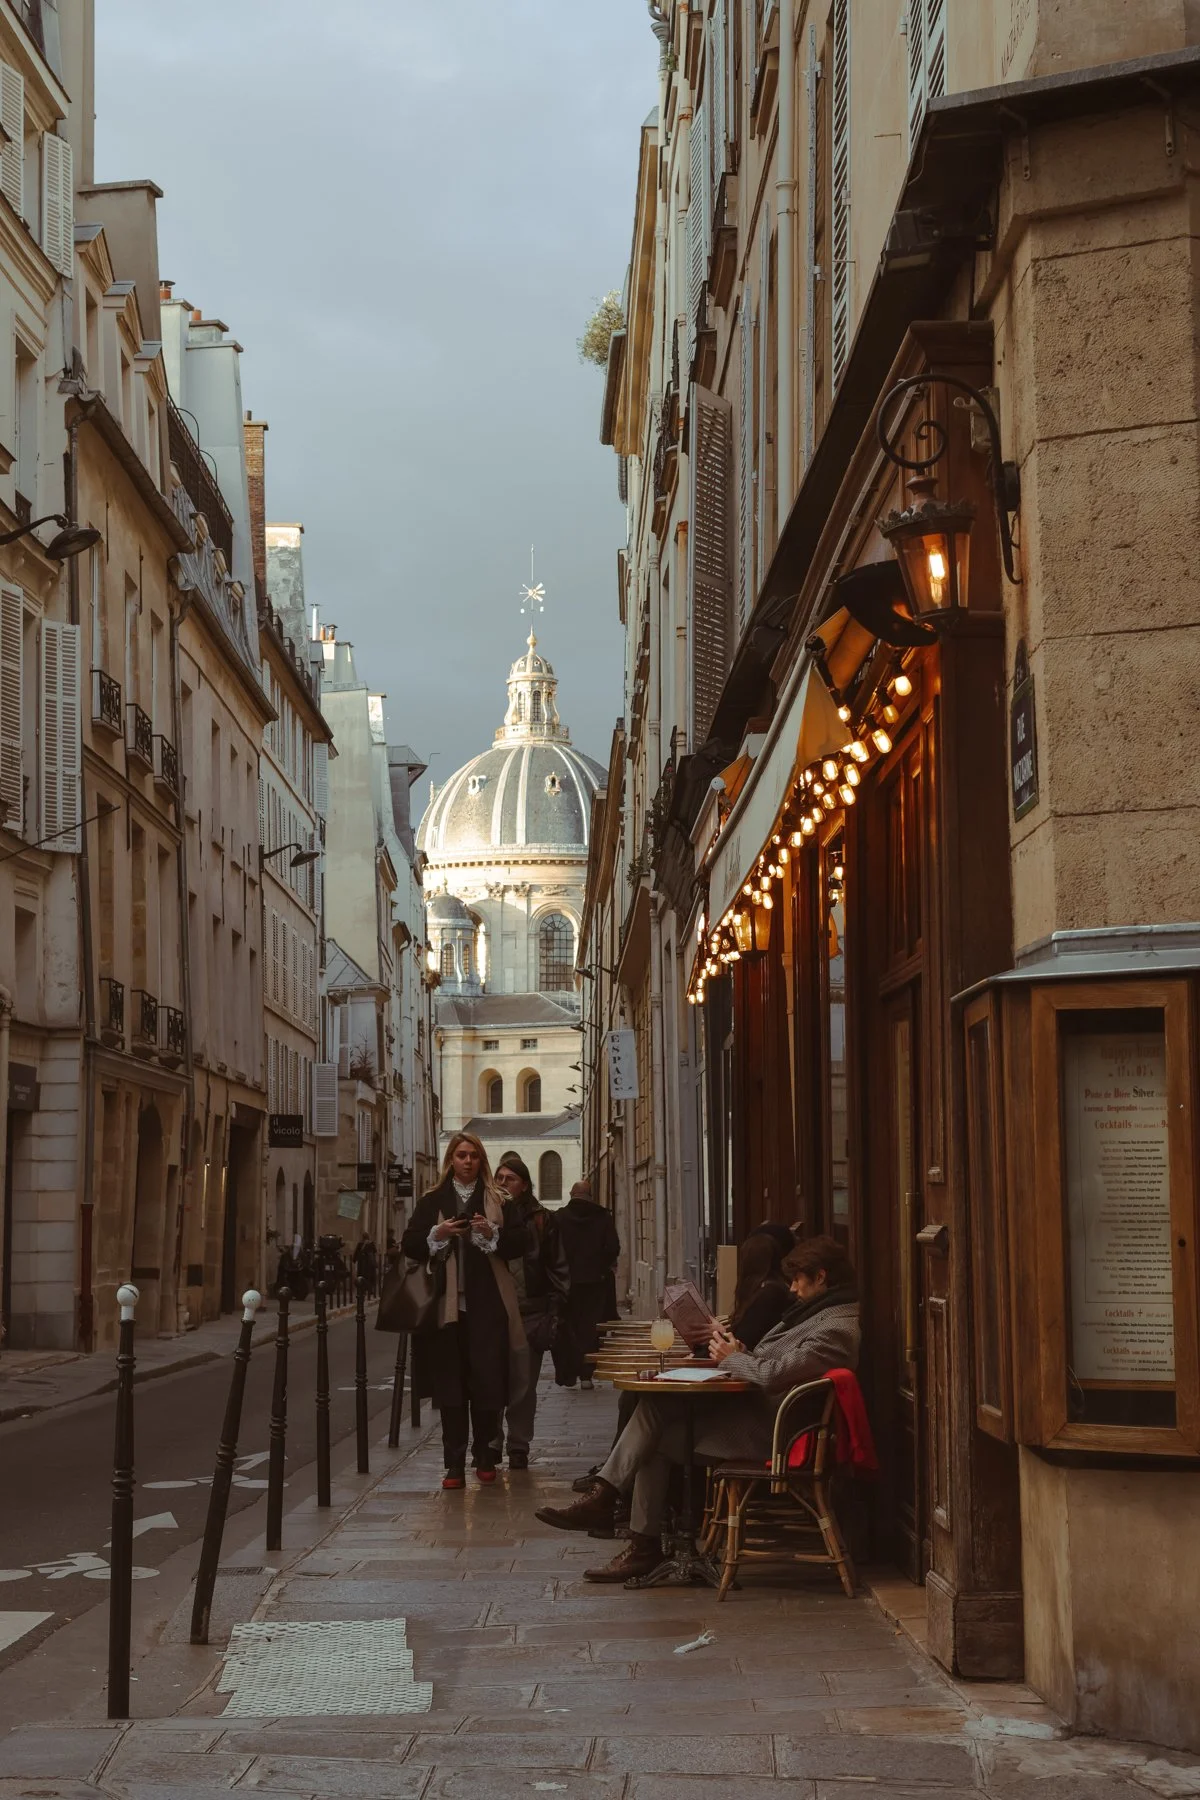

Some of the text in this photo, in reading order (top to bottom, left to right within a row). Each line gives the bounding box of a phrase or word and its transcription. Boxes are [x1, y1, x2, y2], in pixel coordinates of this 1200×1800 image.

[1095, 1119, 1132, 1129] Cocktails
[273, 1126, 301, 1136] vicolo
[1105, 1309, 1134, 1317] Cocktails
[1103, 1346, 1130, 1355] Cocktails
